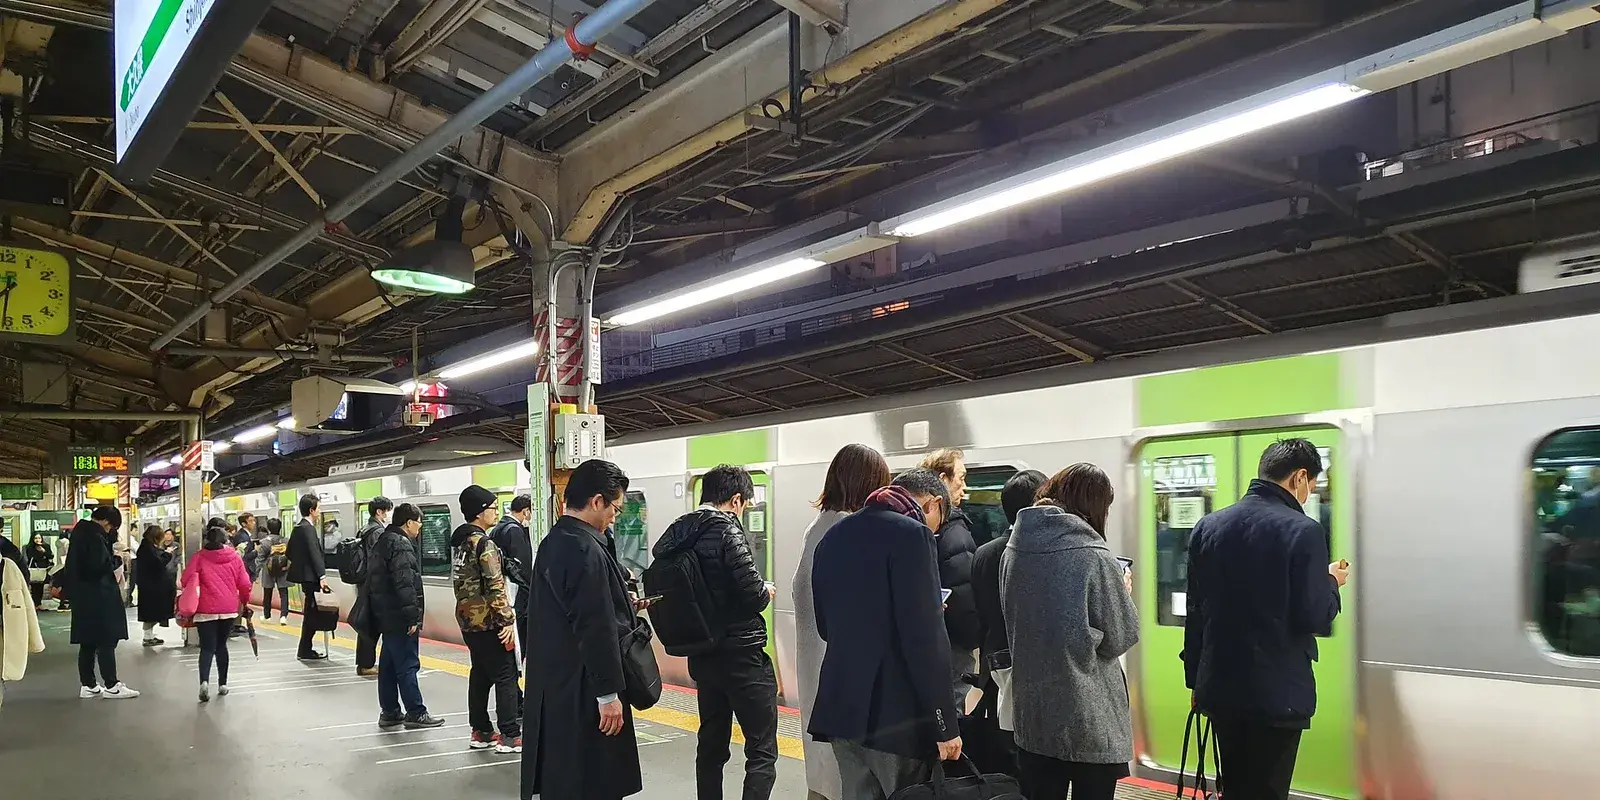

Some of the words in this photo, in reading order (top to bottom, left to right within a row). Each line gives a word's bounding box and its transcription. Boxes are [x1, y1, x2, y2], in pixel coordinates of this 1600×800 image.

[25, 259, 32, 269] 1
[40, 271, 51, 281] 2
[48, 289, 59, 299] 3
[40, 306, 51, 316] 4
[22, 314, 33, 325] 5
[123, 447, 135, 456] 15
[24, 484, 41, 498] 15
